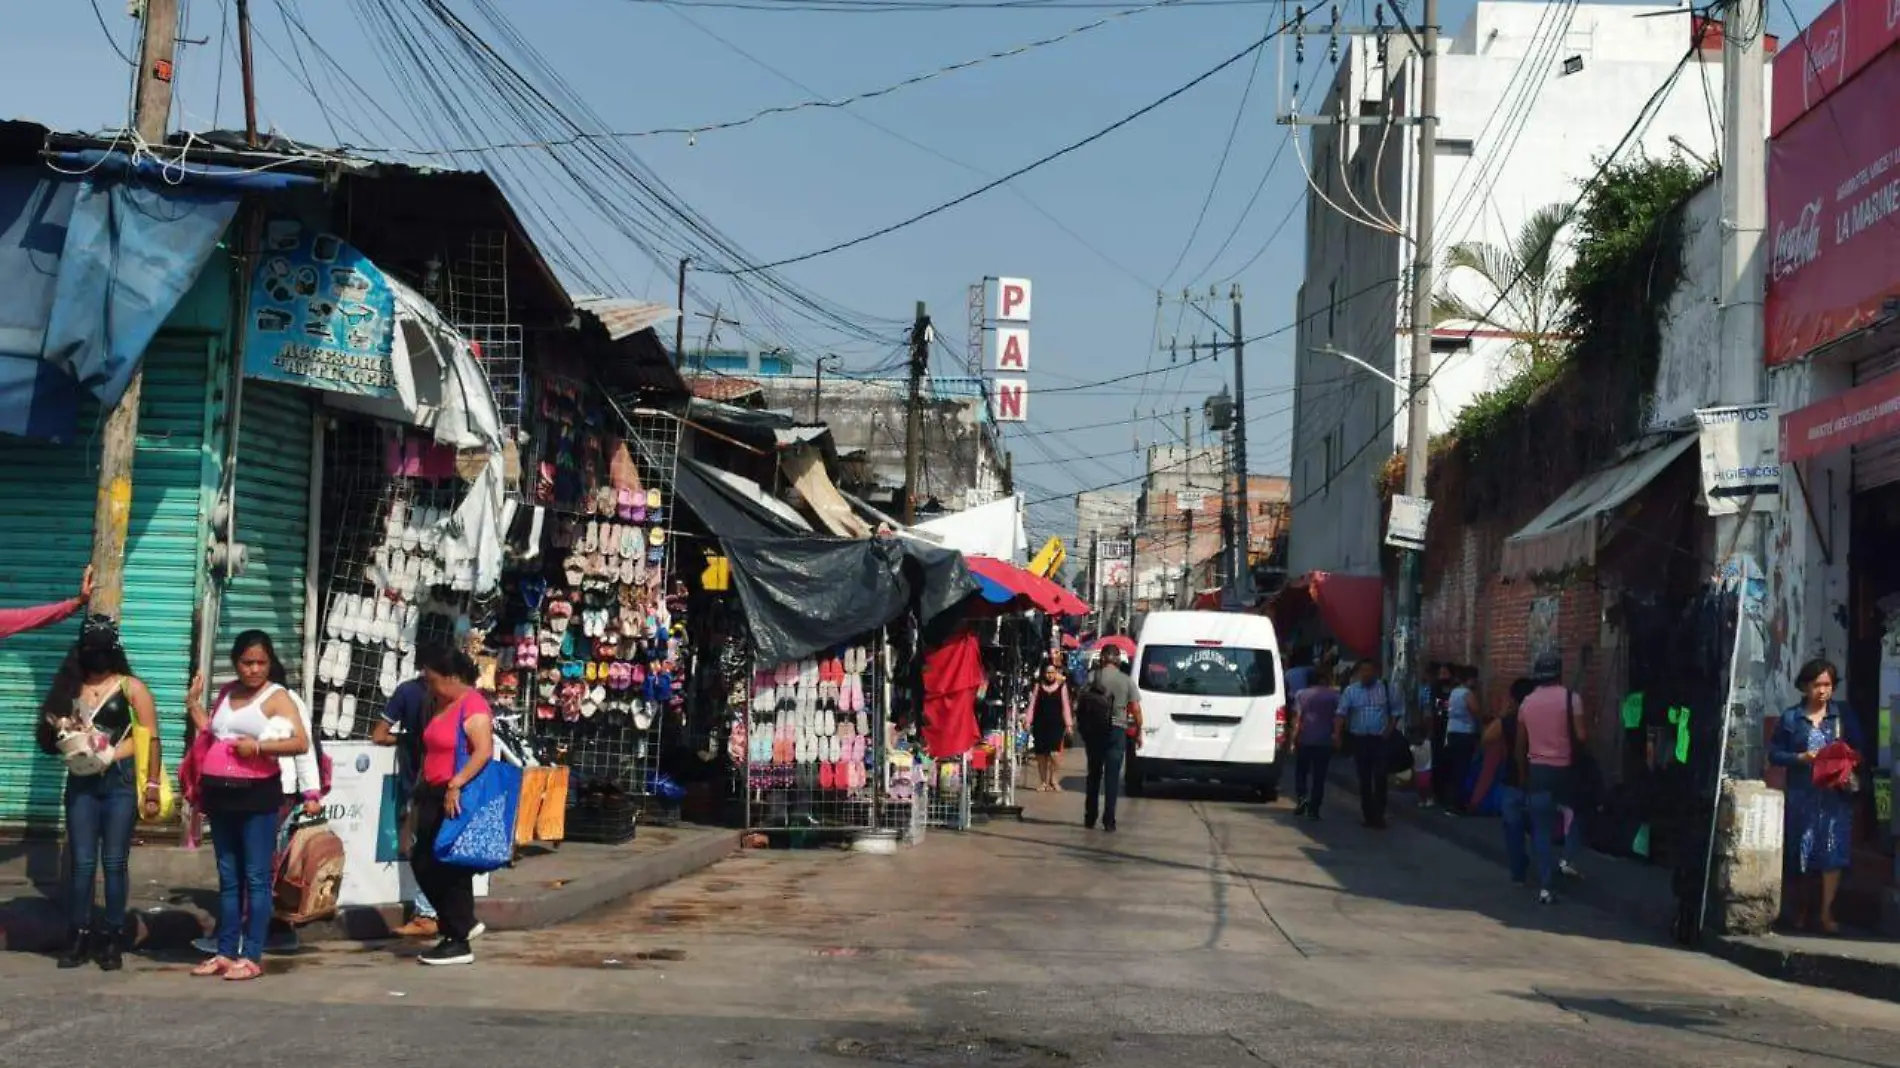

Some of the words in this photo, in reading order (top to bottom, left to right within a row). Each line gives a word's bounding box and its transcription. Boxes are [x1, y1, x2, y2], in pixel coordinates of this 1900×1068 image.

[1772, 196, 1822, 282] Coca-Cola
[1836, 211, 1849, 246] LA
[1000, 284, 1025, 418] PAN
[1703, 408, 1769, 425] LIMPIOS
